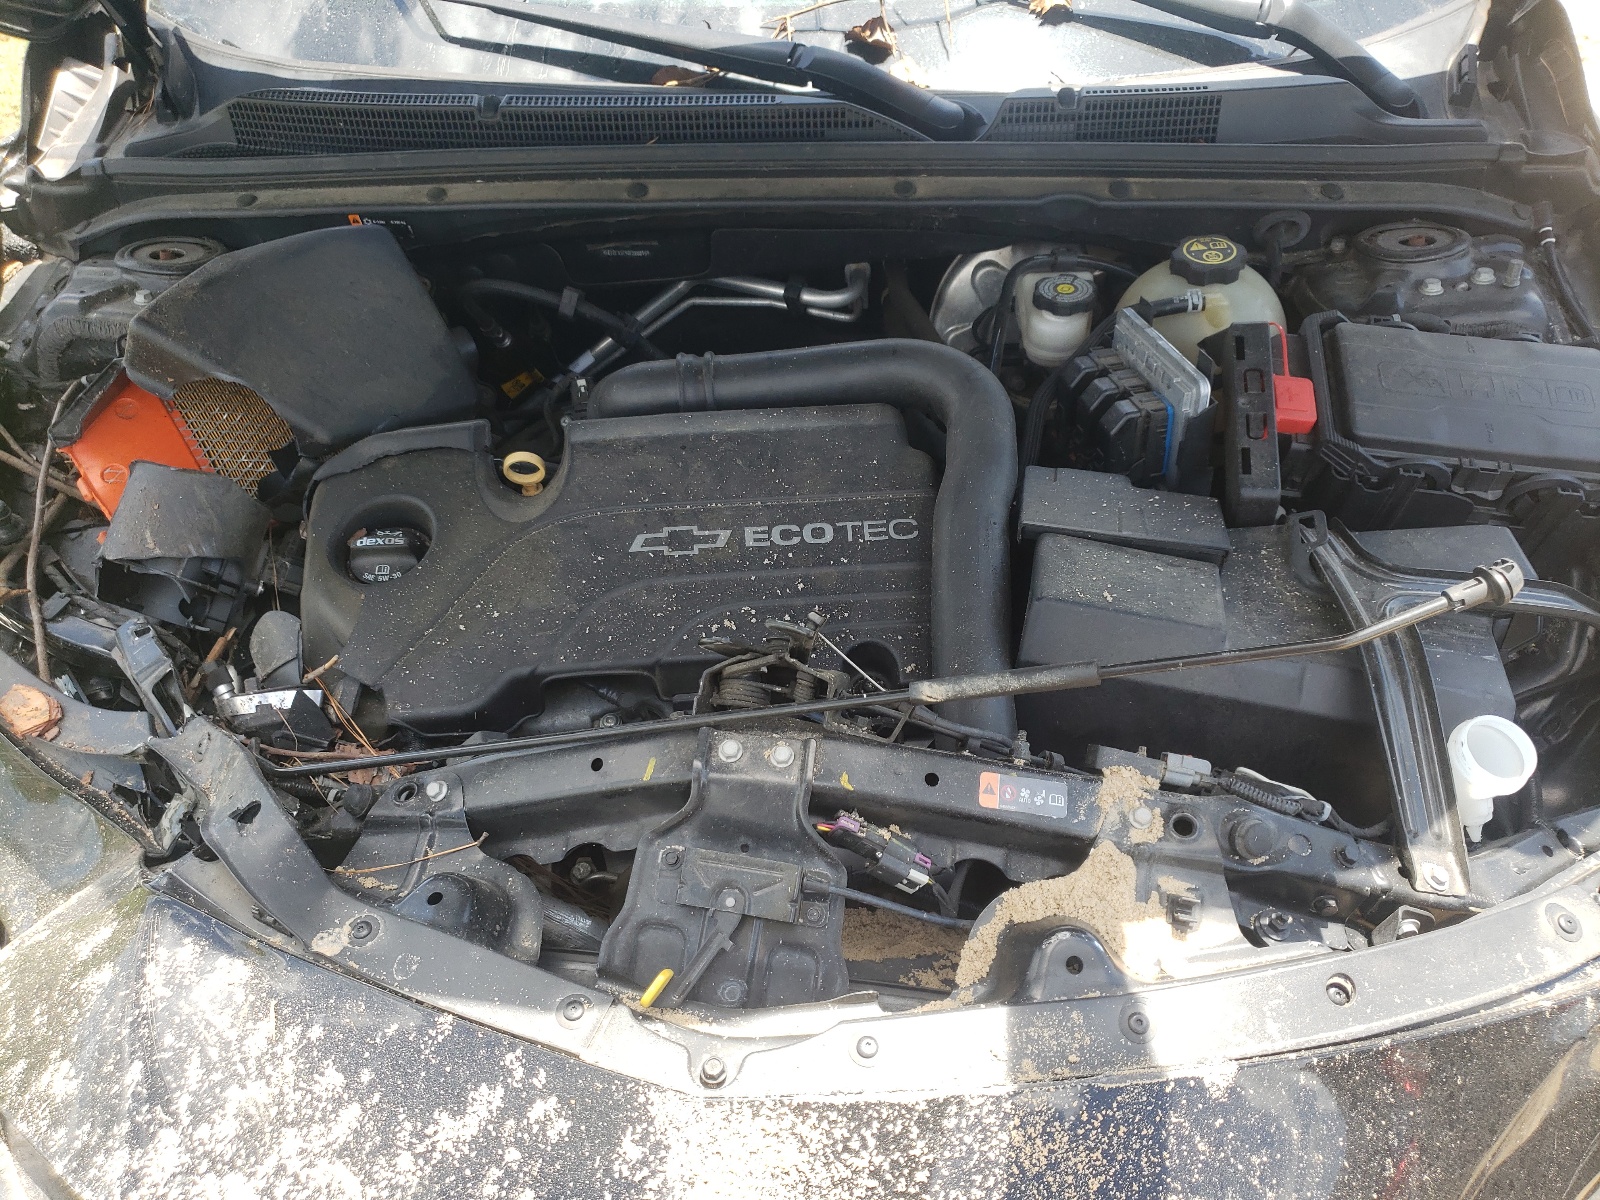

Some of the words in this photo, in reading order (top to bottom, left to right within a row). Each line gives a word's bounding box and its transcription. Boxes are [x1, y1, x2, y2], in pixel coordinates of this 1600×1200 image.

[744, 518, 919, 547] ECOTEC
[356, 536, 405, 547] dexos
[362, 572, 376, 582] SAE
[377, 571, 402, 582] 5W-30
